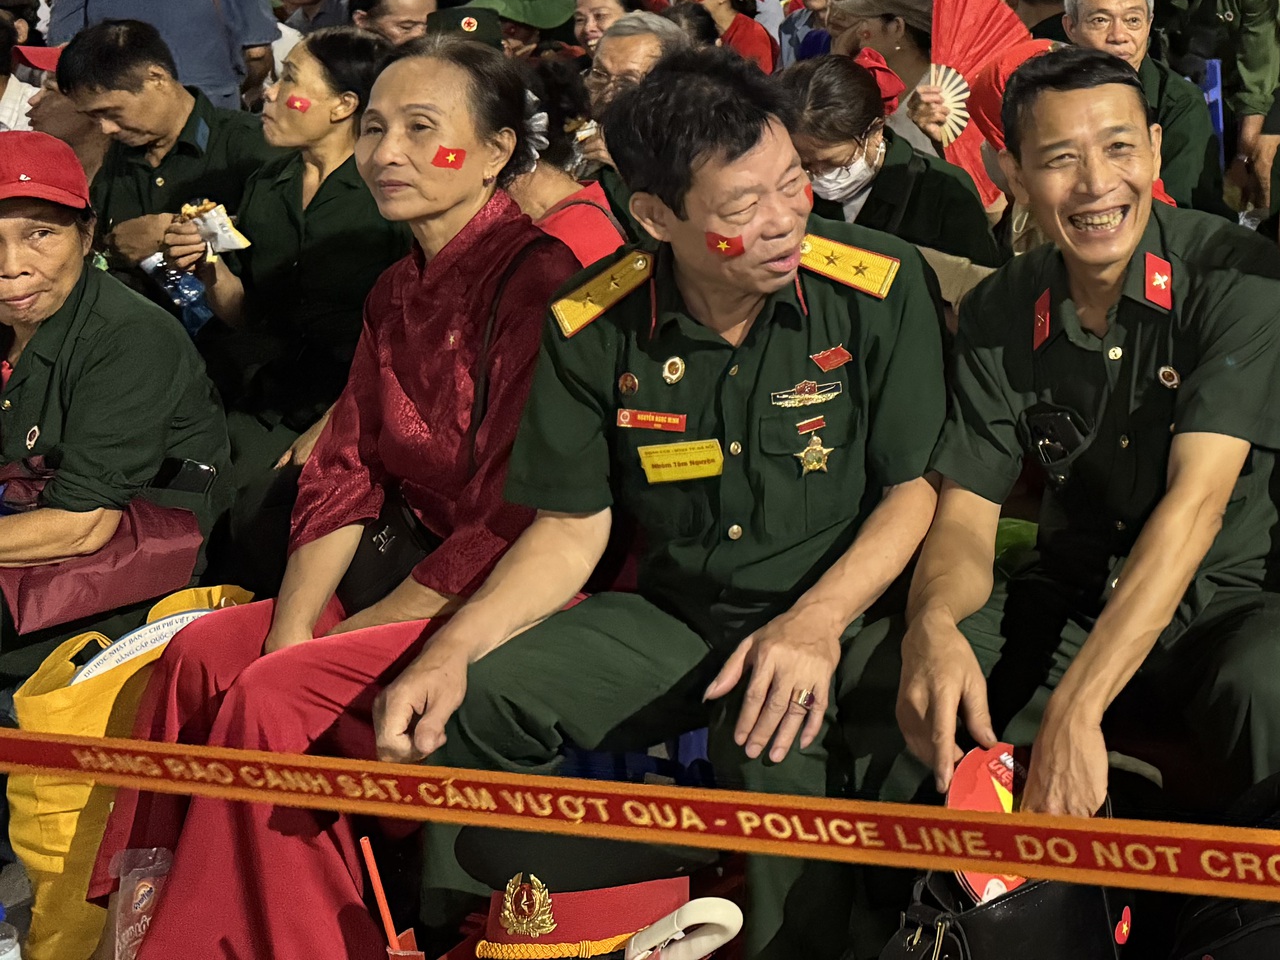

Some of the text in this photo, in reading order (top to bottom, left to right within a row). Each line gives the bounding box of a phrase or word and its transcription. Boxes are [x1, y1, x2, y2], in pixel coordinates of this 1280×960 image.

[71, 746, 162, 777] HÀNG
[163, 754, 234, 785] RÀO
[238, 762, 333, 795] CẢNH
[417, 777, 498, 811] CẤM
[499, 789, 610, 825] VƯỢT
[622, 800, 708, 831] QUA
[736, 810, 886, 848] POLICE
[894, 823, 1002, 858] LINE.
[1014, 833, 1079, 864] DO
[1091, 840, 1182, 873] NOT
